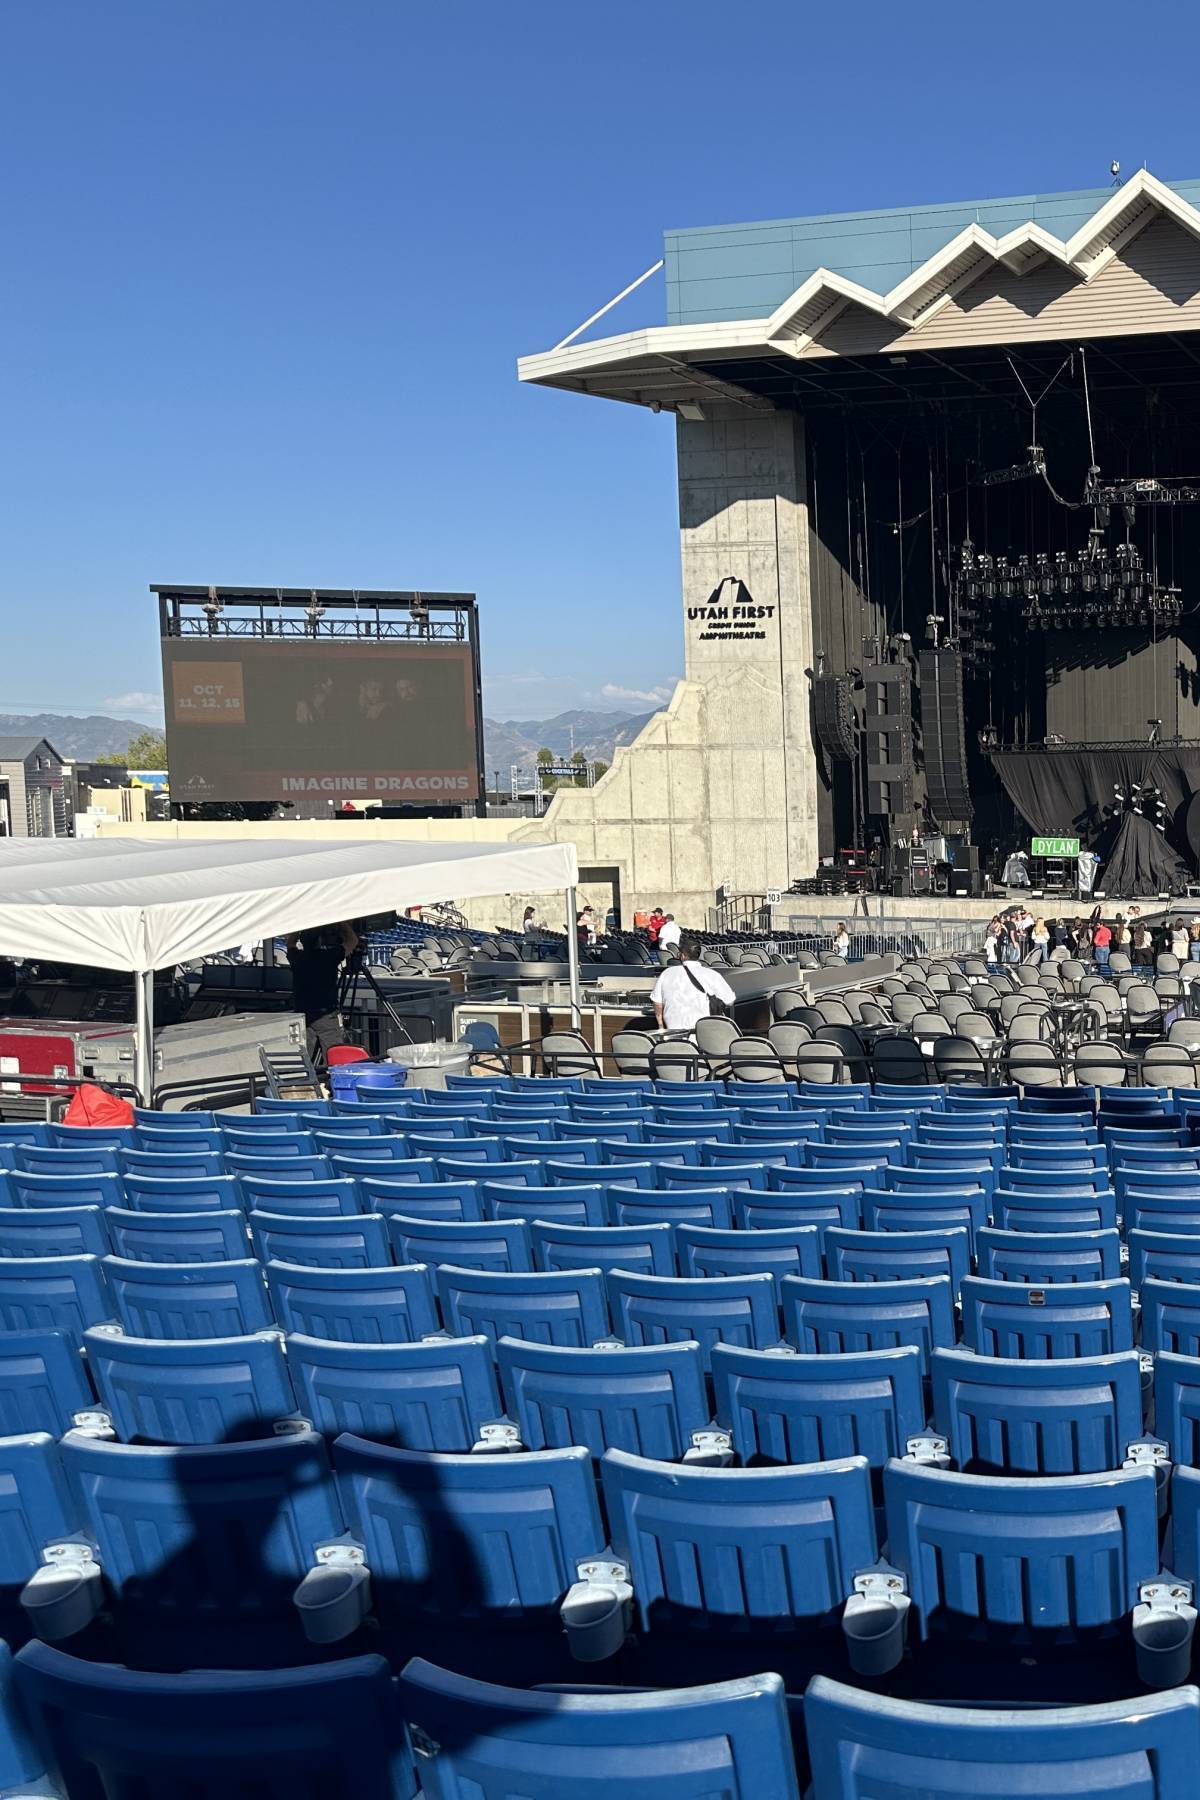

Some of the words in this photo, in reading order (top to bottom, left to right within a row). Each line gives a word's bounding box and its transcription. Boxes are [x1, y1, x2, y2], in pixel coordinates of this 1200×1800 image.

[687, 607, 728, 620] UTAH
[733, 606, 775, 618] FIRST
[192, 684, 225, 695] OCT
[281, 777, 369, 792] IMAGINE
[374, 776, 470, 791] DRAGONS
[1038, 840, 1075, 854] DYLAN
[767, 893, 780, 902] 103
